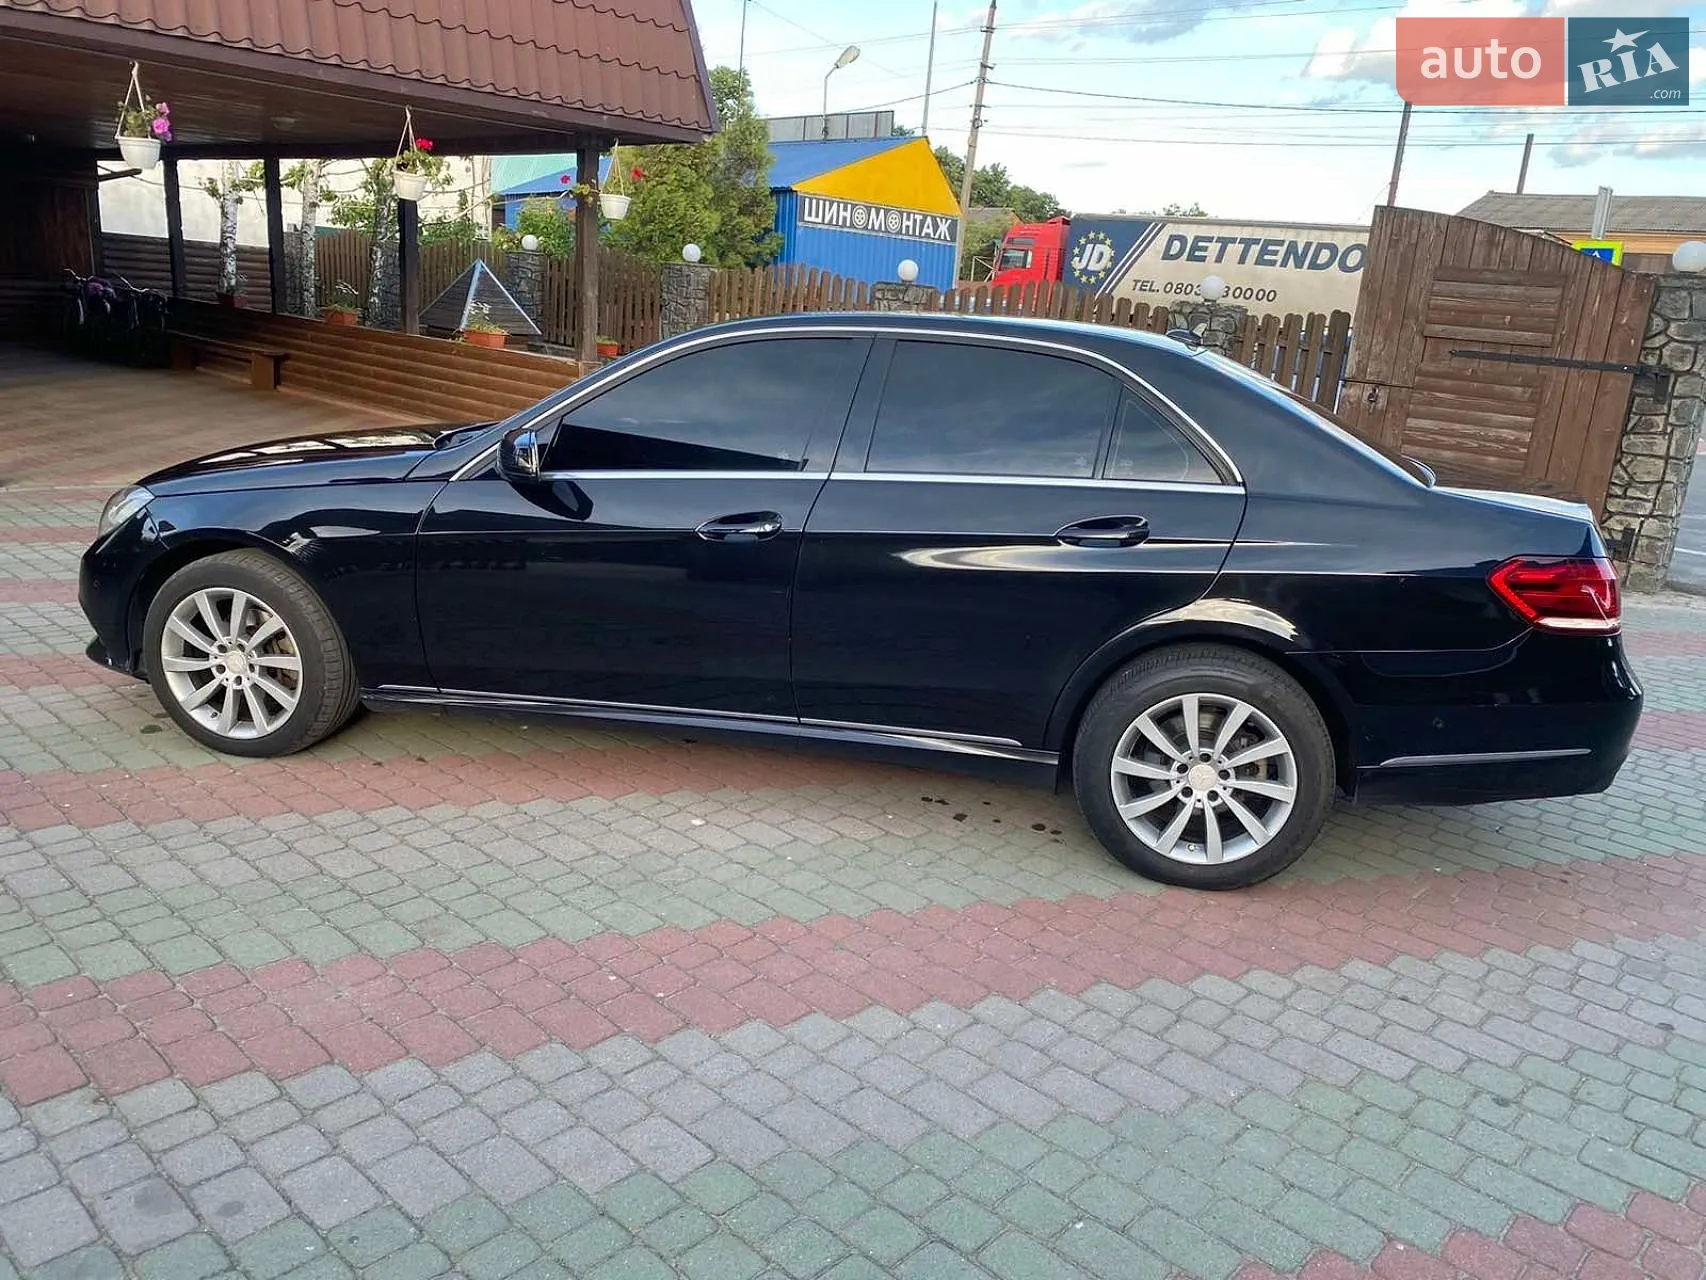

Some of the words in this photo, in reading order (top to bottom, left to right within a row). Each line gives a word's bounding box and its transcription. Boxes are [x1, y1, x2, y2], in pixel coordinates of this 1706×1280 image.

[804, 198, 951, 241] ШИНОМОНТАЖ
[1071, 243, 1111, 271] JD
[1160, 234, 1368, 273] DETTENDO
[1132, 280, 1159, 293] TEL.
